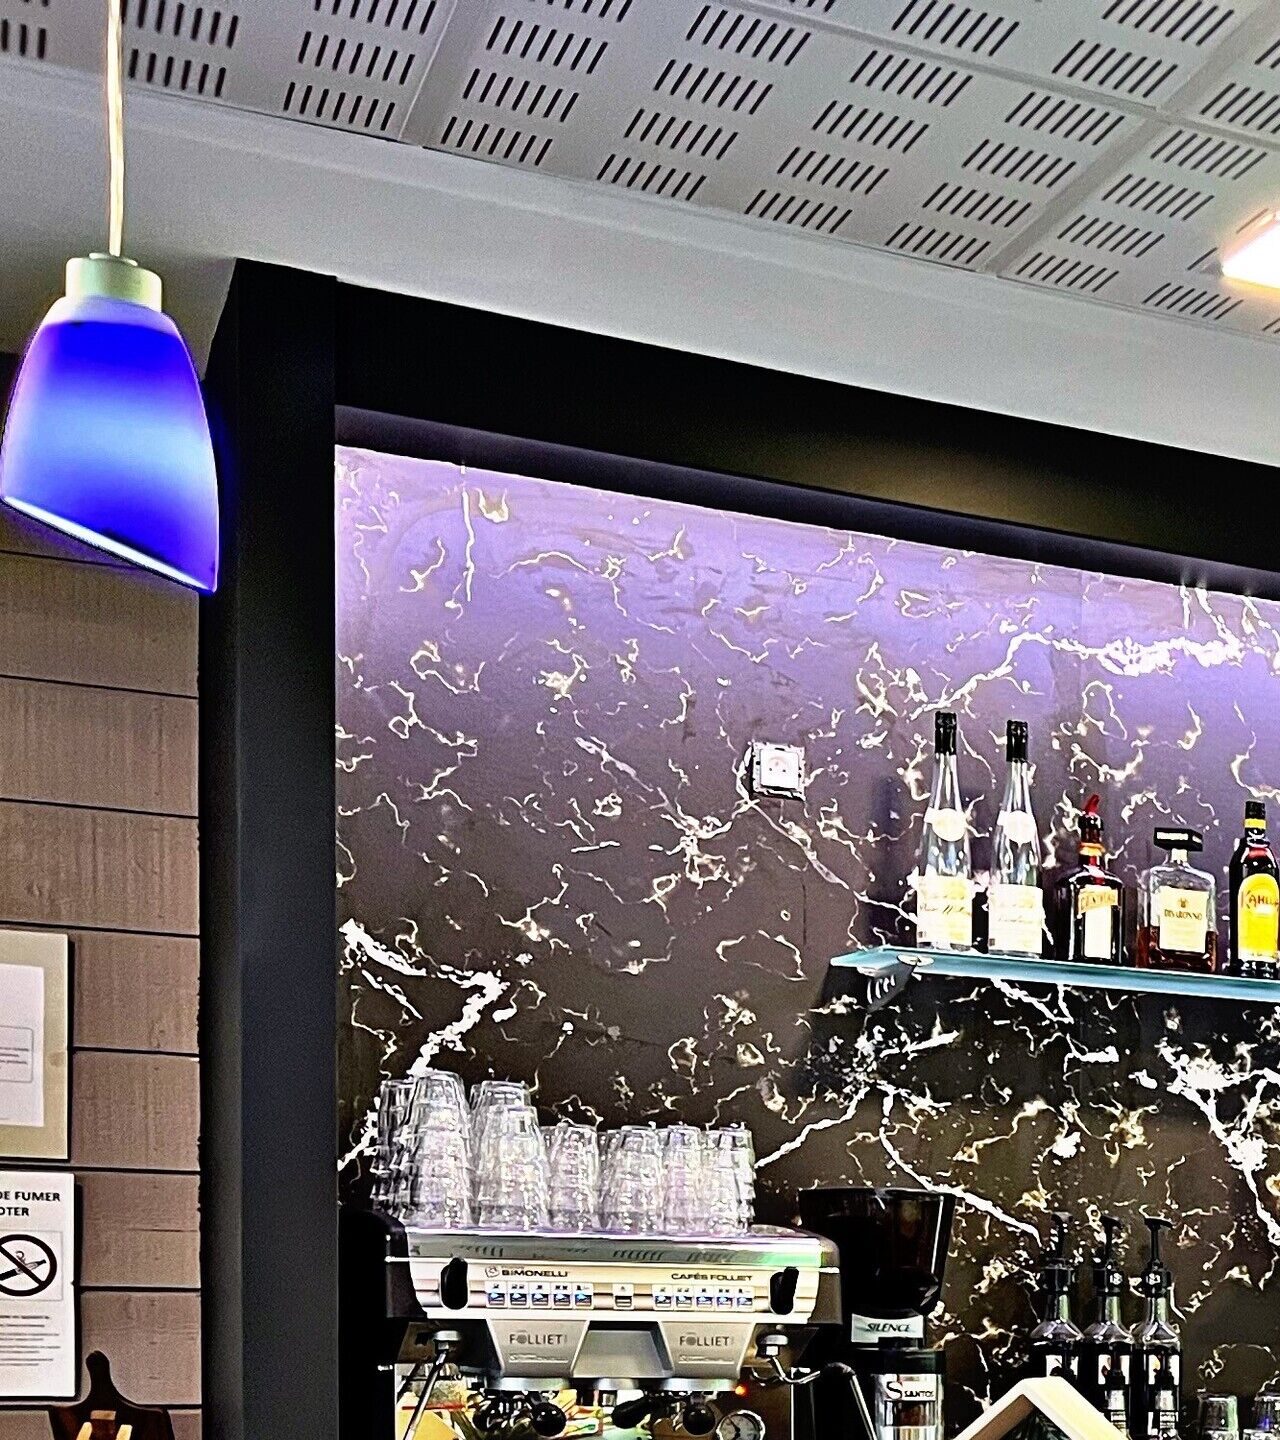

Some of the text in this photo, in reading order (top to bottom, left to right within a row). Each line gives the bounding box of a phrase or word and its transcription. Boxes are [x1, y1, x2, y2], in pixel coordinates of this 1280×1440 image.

[1163, 909, 1204, 921] DISARONNO
[14, 1191, 61, 1202] FUMER
[509, 1333, 563, 1346] FOLLIET
[679, 1335, 729, 1347] FOLLIET
